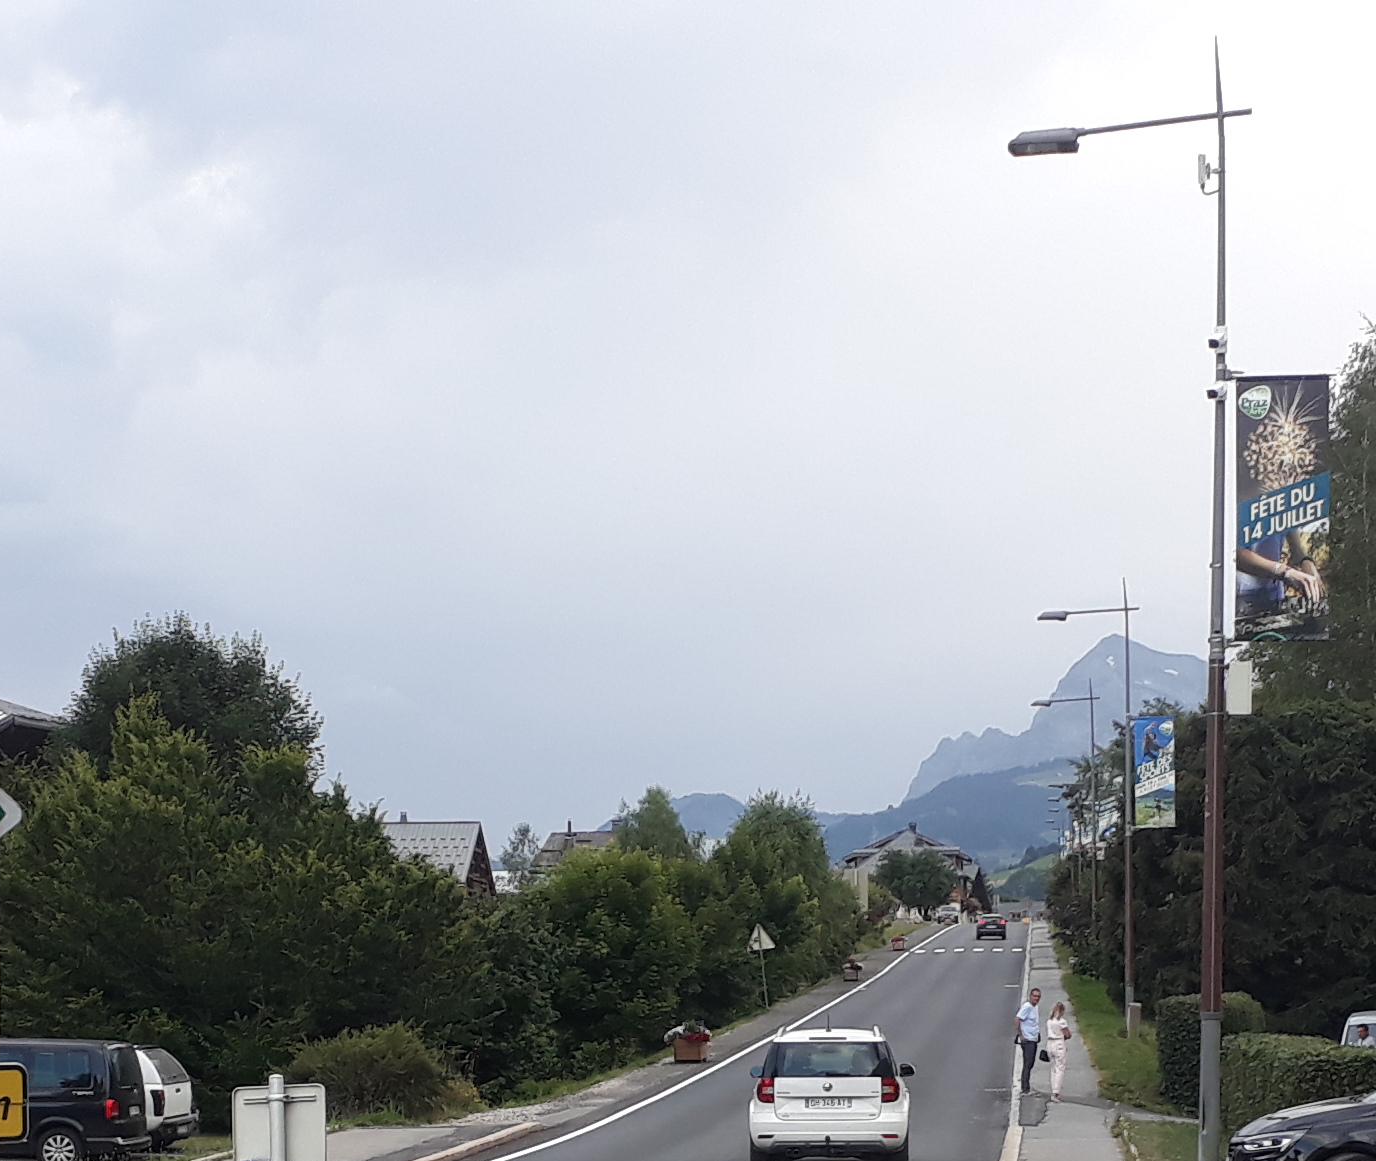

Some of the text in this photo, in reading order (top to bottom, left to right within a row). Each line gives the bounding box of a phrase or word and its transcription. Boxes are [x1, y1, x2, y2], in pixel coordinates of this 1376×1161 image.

[1242, 499, 1325, 544] 14 JUILLET
[1250, 482, 1315, 521] FÊTE DU
